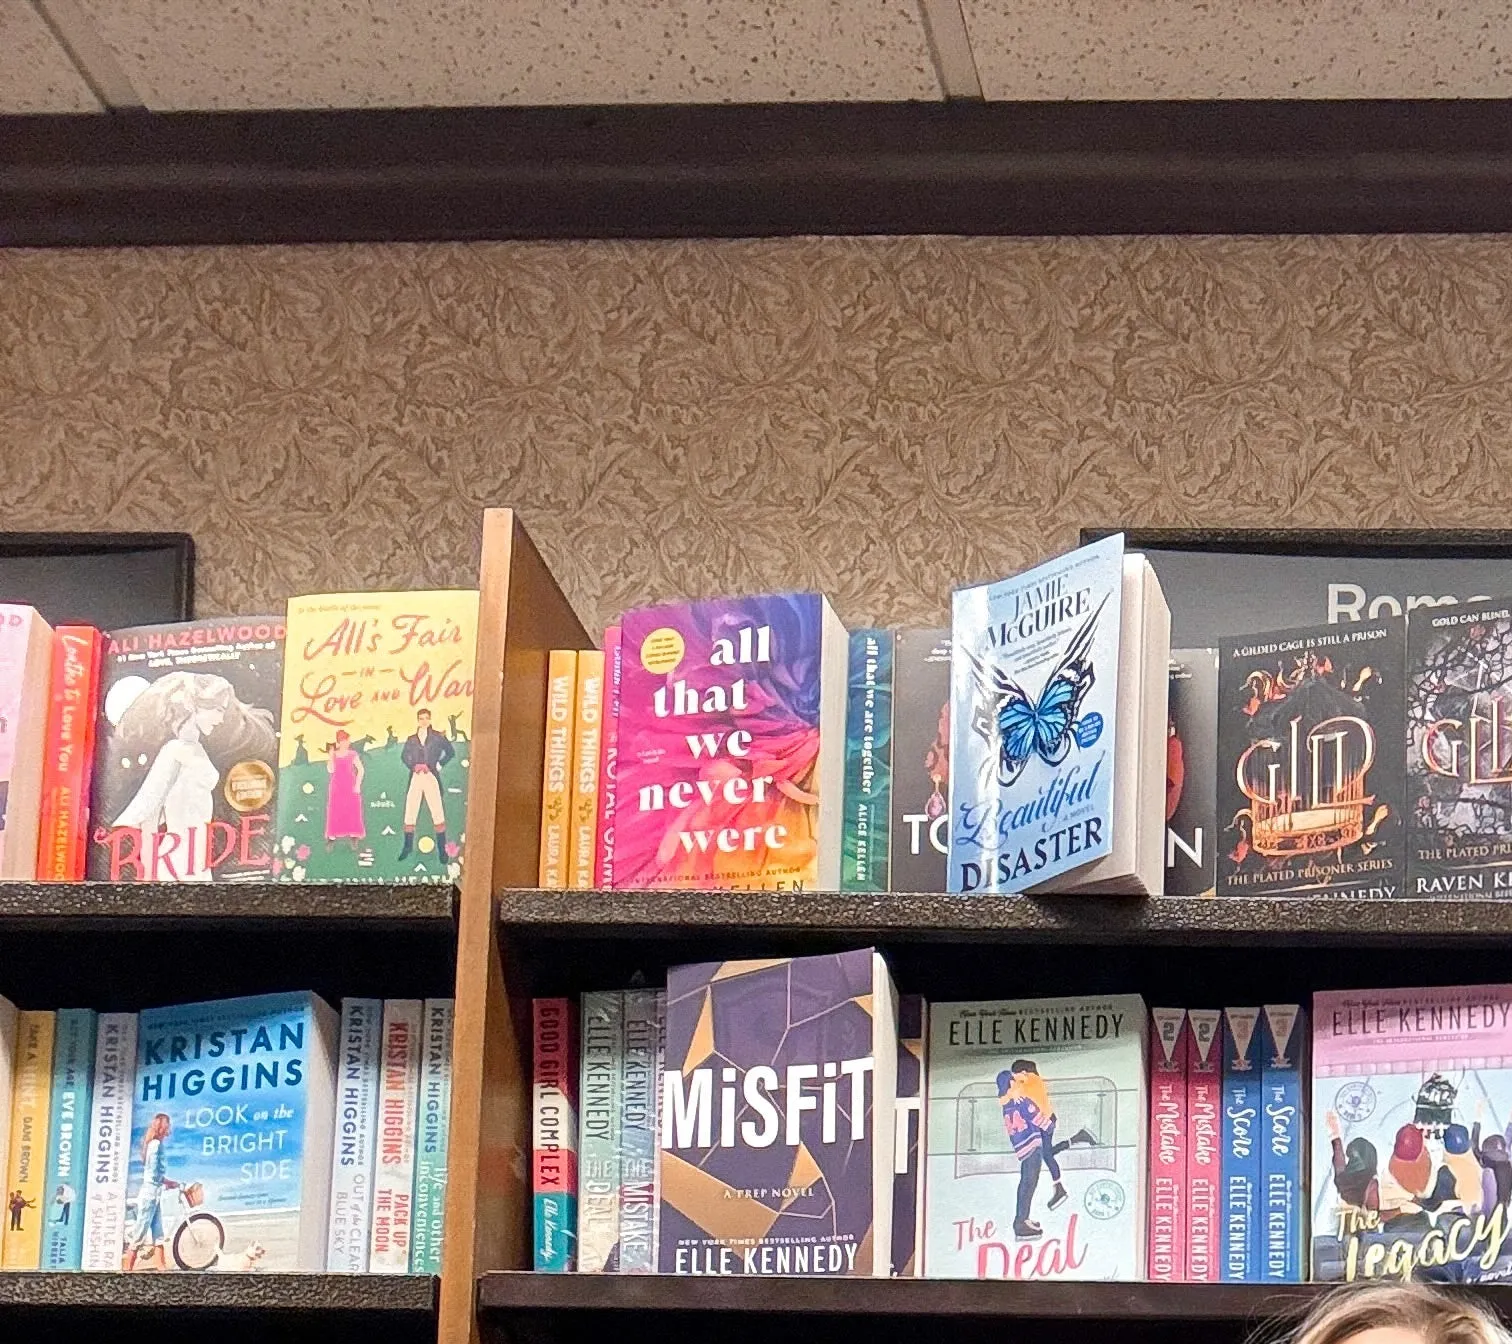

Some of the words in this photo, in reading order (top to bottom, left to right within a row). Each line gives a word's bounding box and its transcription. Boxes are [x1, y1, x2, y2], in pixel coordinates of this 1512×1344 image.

[1012, 572, 1070, 623] JAMIE
[107, 634, 142, 655] ALI
[147, 624, 288, 645] HAZELWOOD
[303, 617, 383, 661] All's
[389, 614, 462, 655] Fair
[709, 625, 772, 666] all
[360, 667, 375, 677] IN
[291, 672, 363, 727] Love
[652, 678, 748, 718] that
[685, 727, 752, 758] we
[638, 774, 774, 812] never
[954, 750, 1106, 851] Beautiful
[94, 813, 271, 882] BRIDE
[678, 820, 787, 854] were
[960, 816, 1103, 894] DISASTER
[1227, 875, 1248, 886] THE
[1252, 871, 1294, 883] PLATED
[1358, 859, 1393, 872] SERIES
[539, 1005, 561, 1052] GOOD
[948, 1014, 1002, 1048] ELLE
[1013, 1012, 1125, 1042] KENNEDY
[1332, 1010, 1388, 1037] ELLE
[1398, 1004, 1511, 1033] KENNEDY
[144, 1020, 306, 1067] KRISTAN
[142, 1057, 303, 1101] HIGGINS
[538, 1058, 561, 1101] GIRL
[184, 1104, 248, 1128] LOOK
[253, 1110, 269, 1121] on
[272, 1104, 294, 1120] the
[202, 1130, 286, 1157] BRIGHT
[537, 1104, 561, 1187] COMPLEX
[240, 1160, 292, 1183] SIDE
[953, 1215, 997, 1253] The
[1334, 1205, 1381, 1242] The
[675, 1246, 736, 1276] ELLE
[742, 1242, 857, 1275] KENNEDY
[974, 1212, 1089, 1281] Deal
